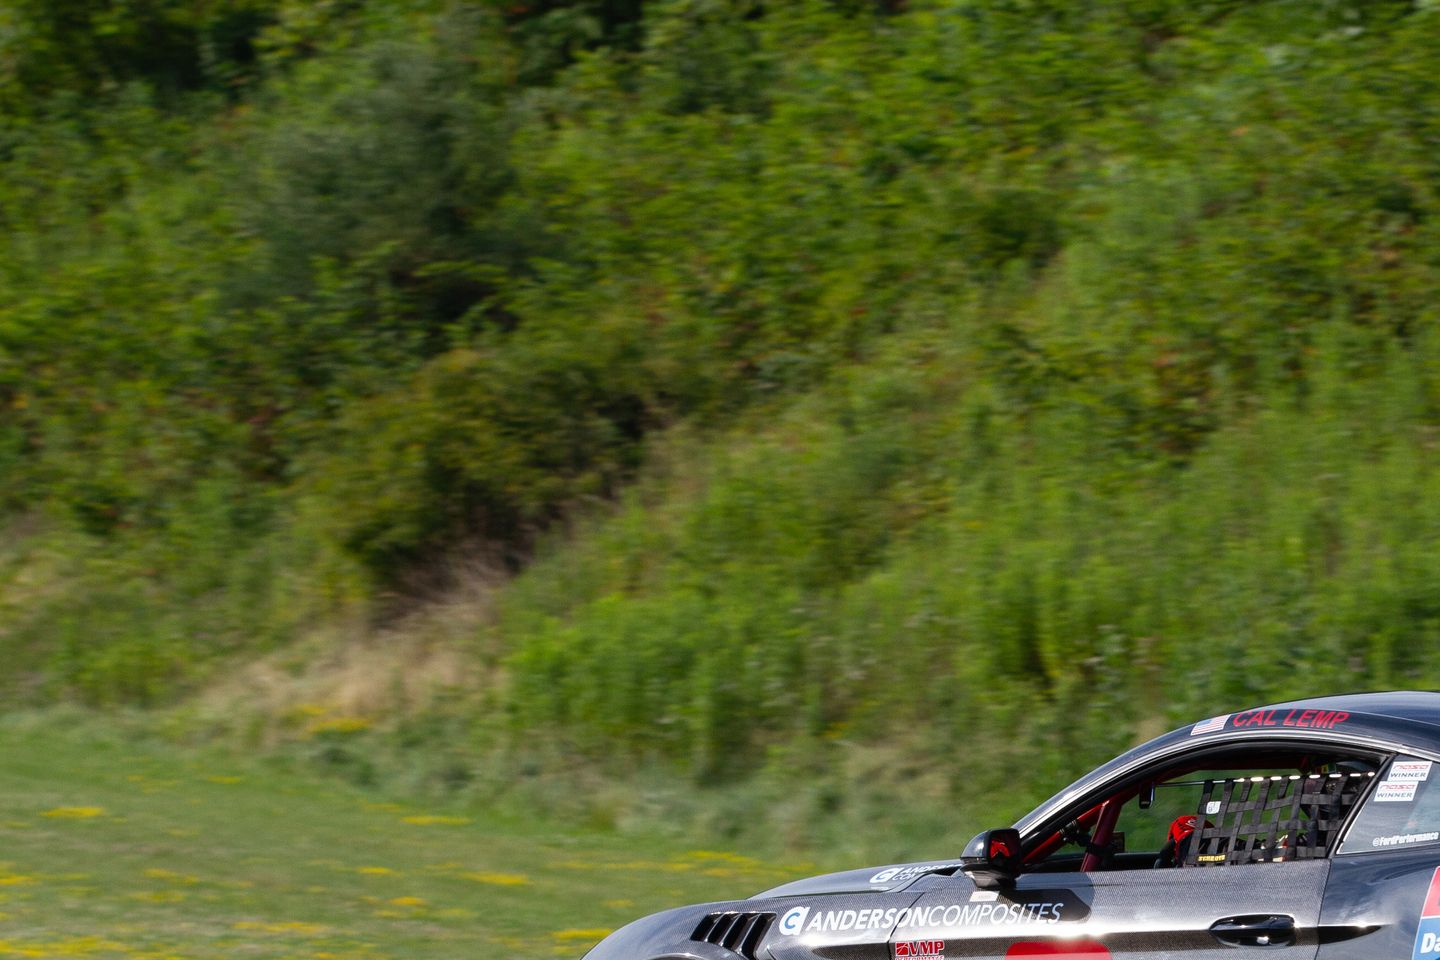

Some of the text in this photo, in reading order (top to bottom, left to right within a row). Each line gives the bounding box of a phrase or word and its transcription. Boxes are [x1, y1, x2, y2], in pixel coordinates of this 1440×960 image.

[1232, 709, 1350, 729] CAL LEMP
[908, 941, 945, 956] VMP
